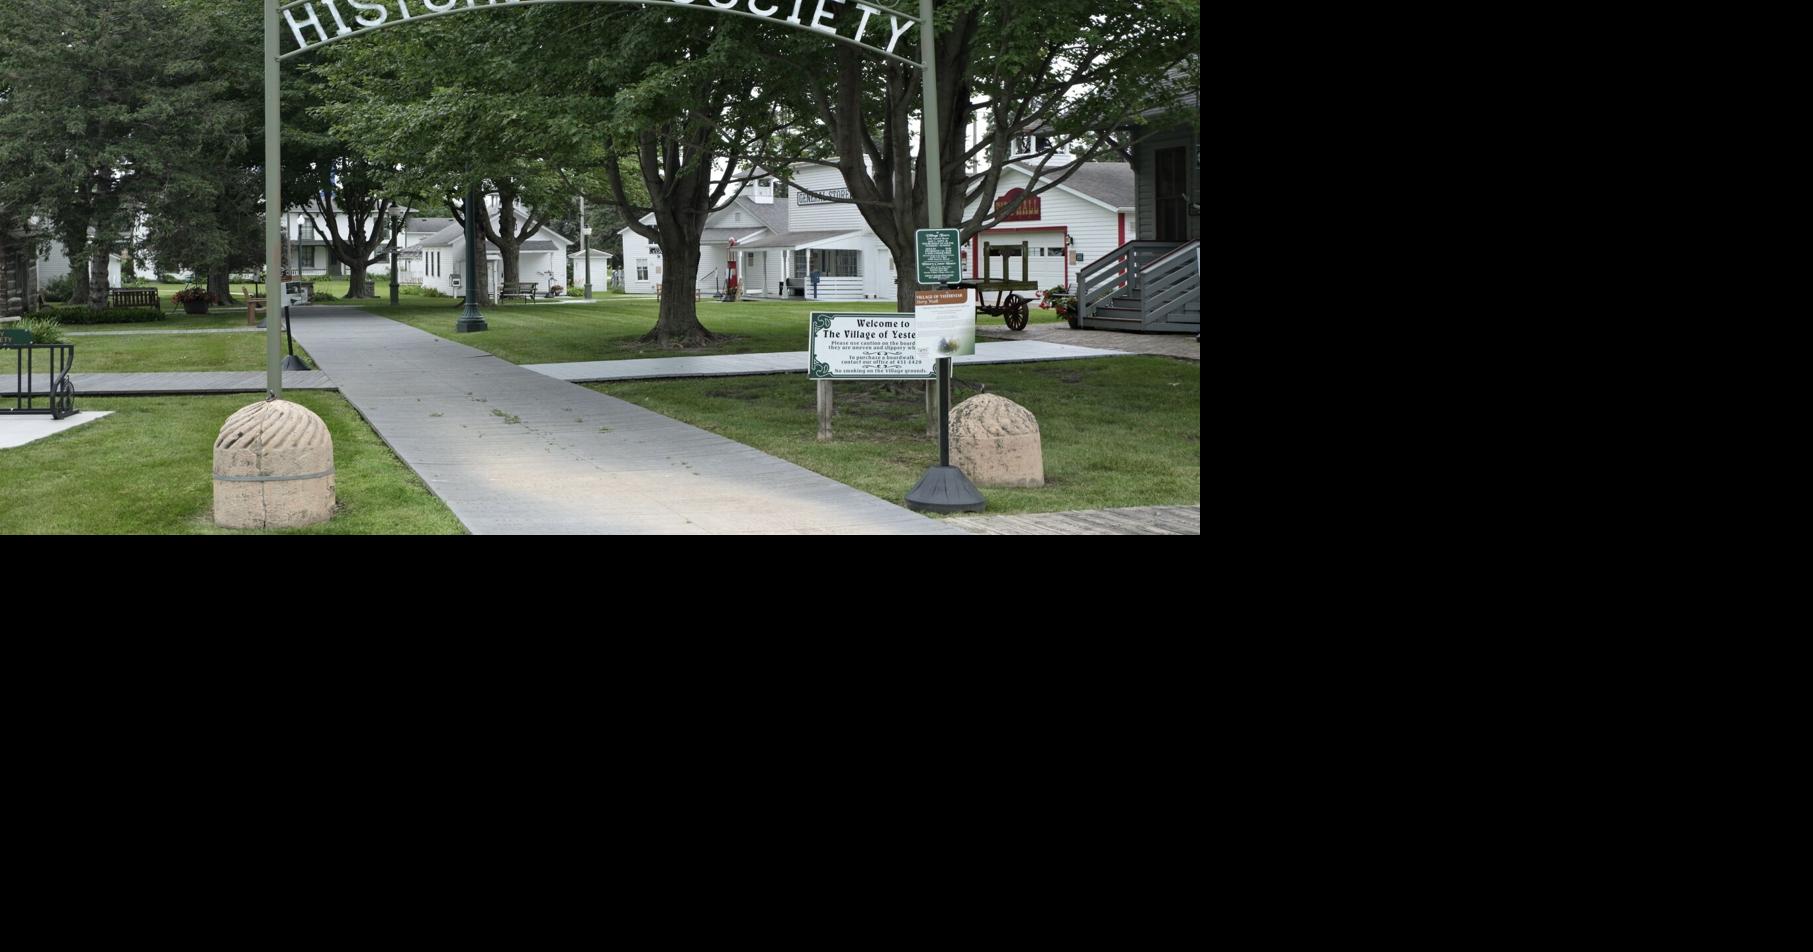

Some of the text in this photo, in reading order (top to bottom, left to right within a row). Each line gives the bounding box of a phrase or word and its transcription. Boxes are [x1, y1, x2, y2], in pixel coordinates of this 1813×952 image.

[856, 319, 910, 328] Welcome to
[823, 330, 916, 340] The Village of Yeste
